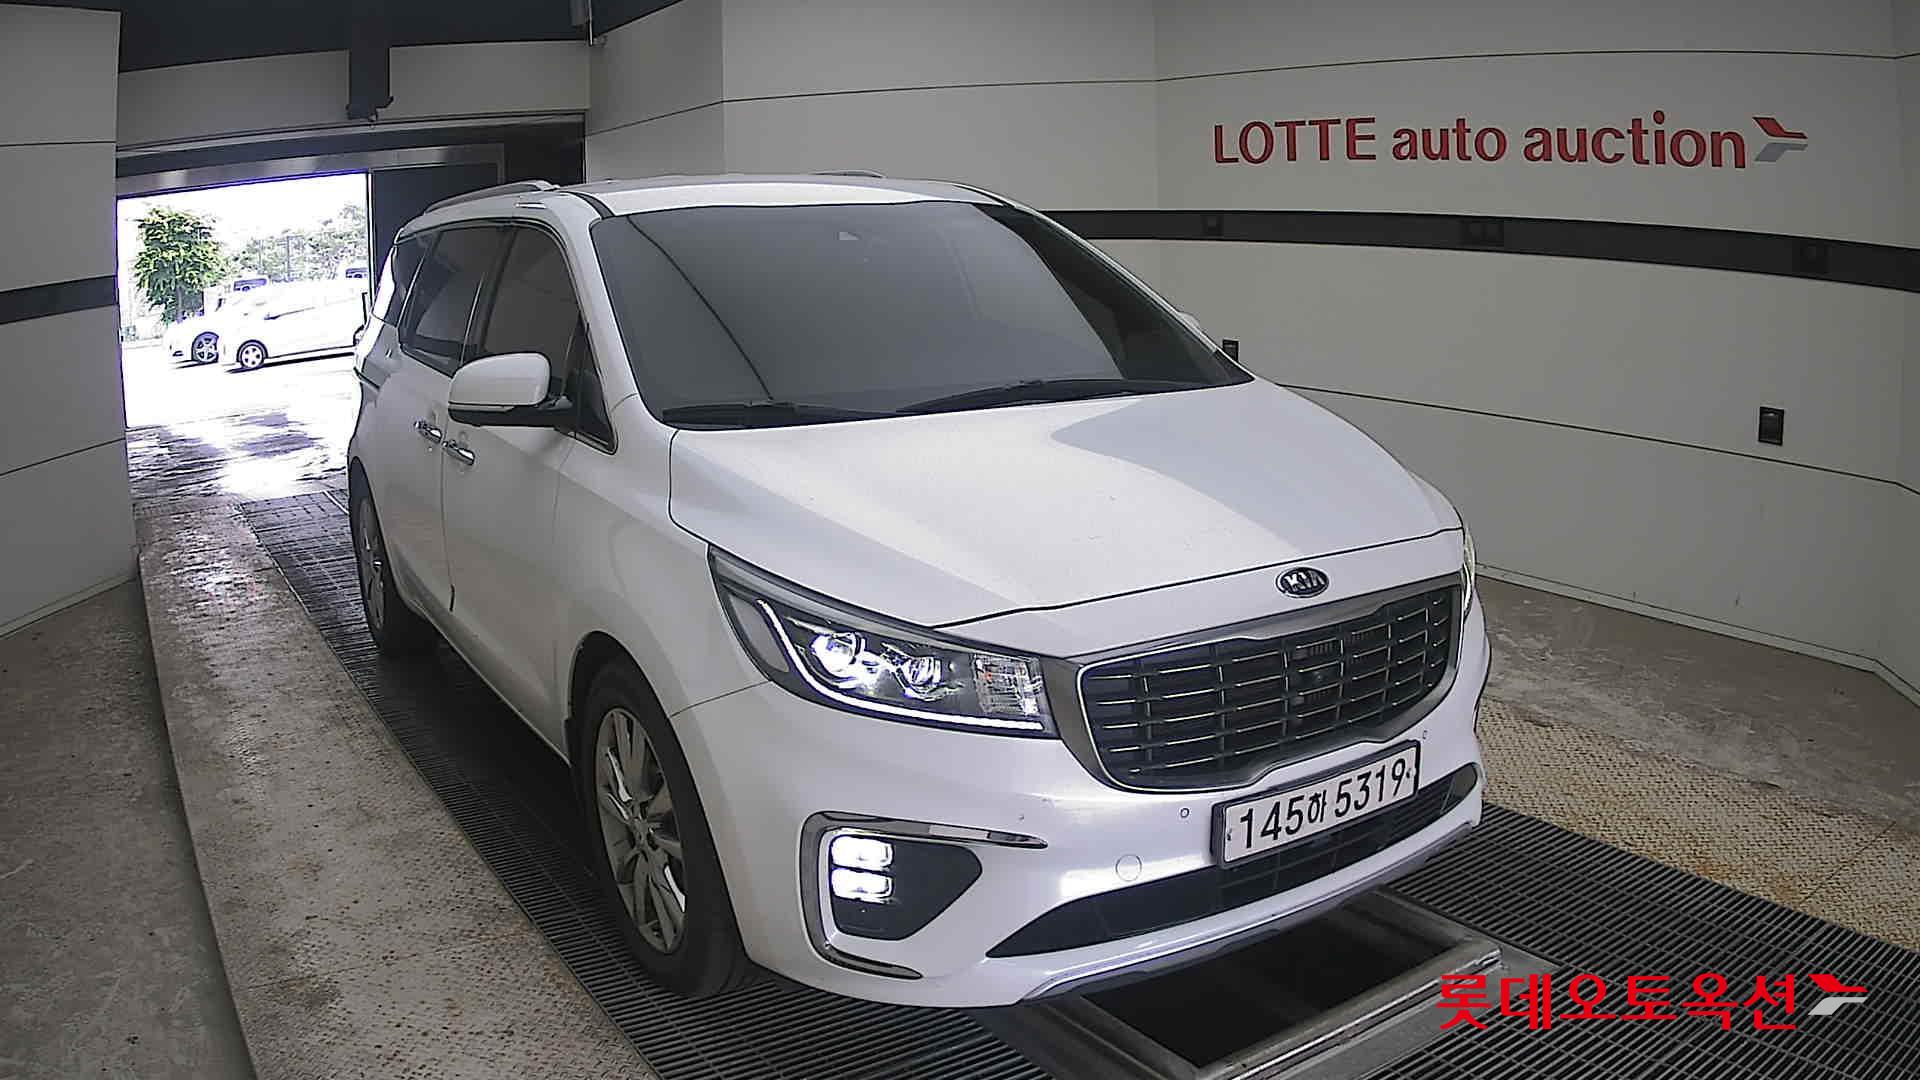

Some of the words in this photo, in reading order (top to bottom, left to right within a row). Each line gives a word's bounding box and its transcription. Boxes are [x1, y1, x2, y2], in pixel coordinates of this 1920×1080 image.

[1214, 116, 1377, 164] LOTTE
[1392, 117, 1508, 162] auto
[1522, 110, 1747, 169] auction
[1283, 570, 1325, 592] KIA
[1239, 788, 1327, 849] 145하
[1334, 757, 1407, 818] 5319
